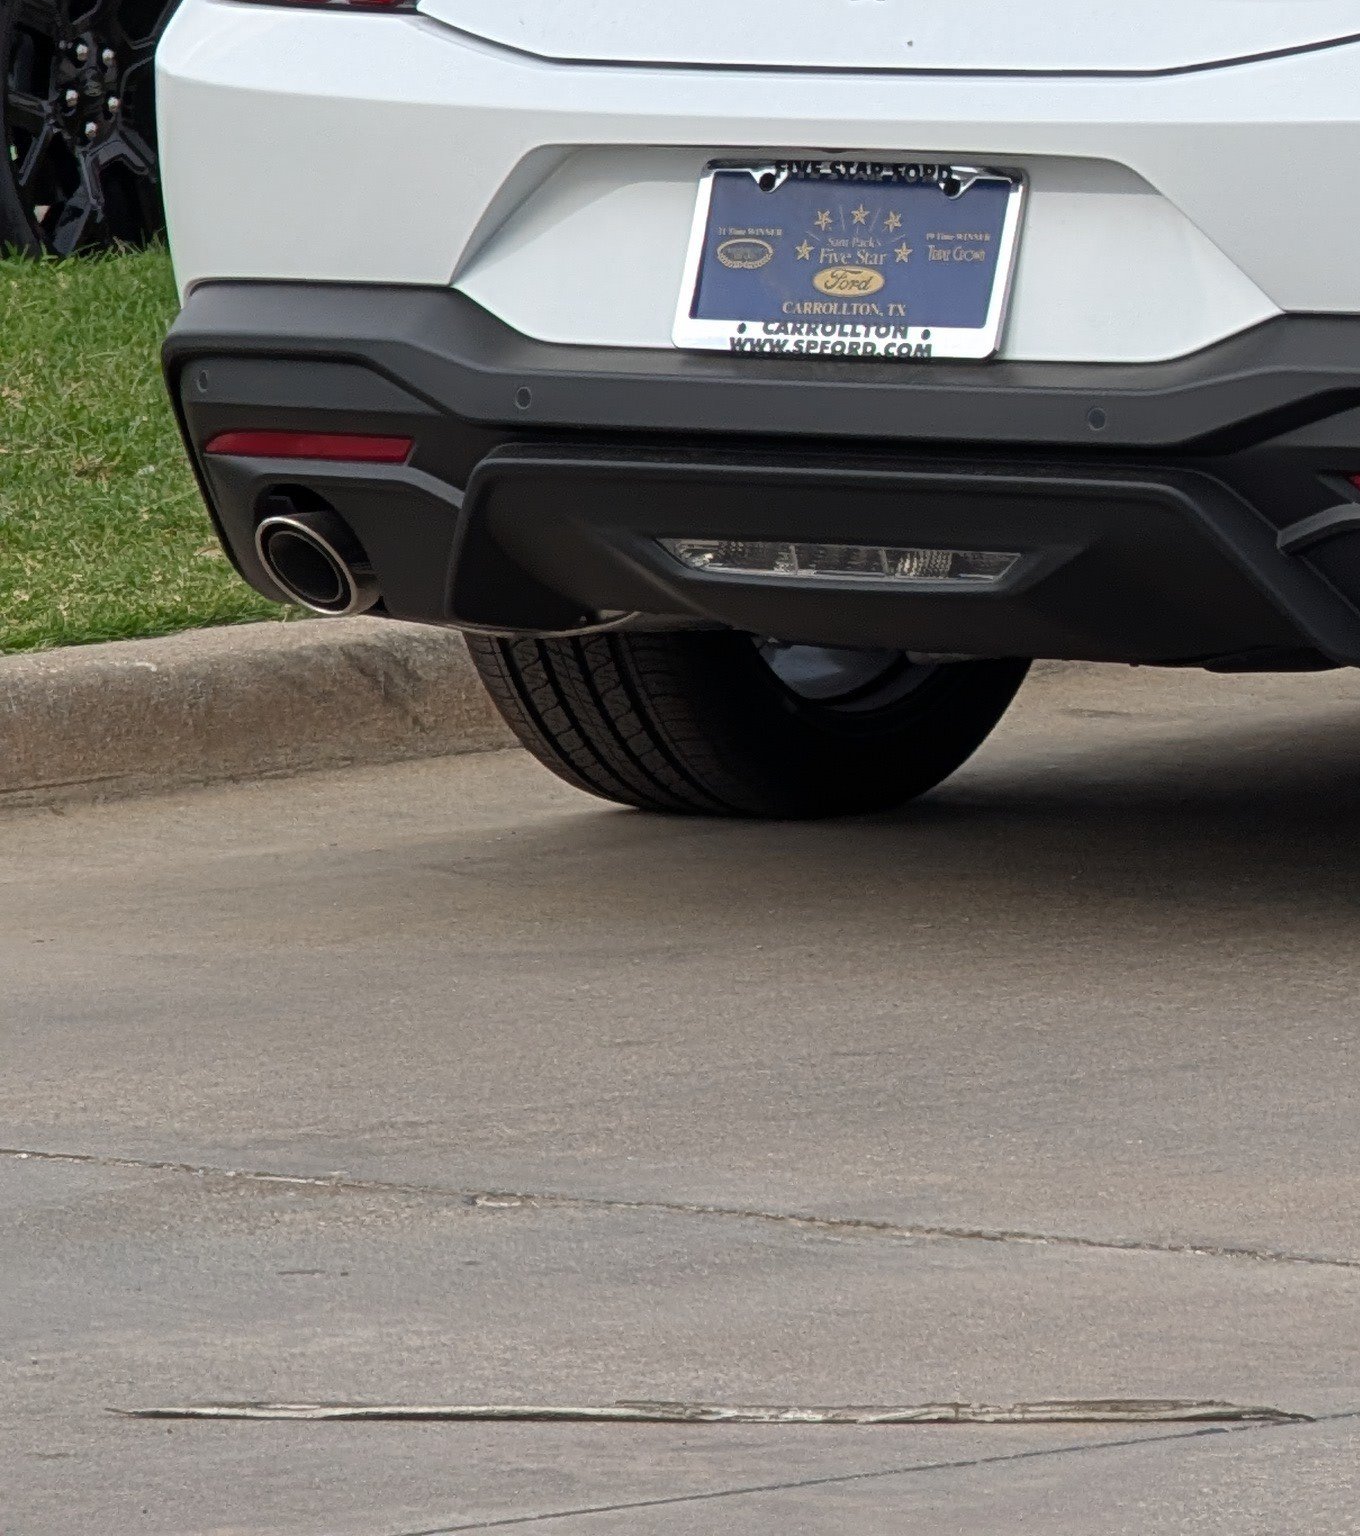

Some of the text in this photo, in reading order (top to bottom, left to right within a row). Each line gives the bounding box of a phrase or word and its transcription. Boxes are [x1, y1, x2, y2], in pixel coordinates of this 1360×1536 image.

[891, 163, 952, 183] FORD
[819, 247, 888, 265] Five Star
[823, 268, 876, 292] Ford
[887, 303, 907, 317] TX
[762, 321, 909, 339] CARROLLTON
[729, 336, 933, 358] WWW.SPFORD.COM
